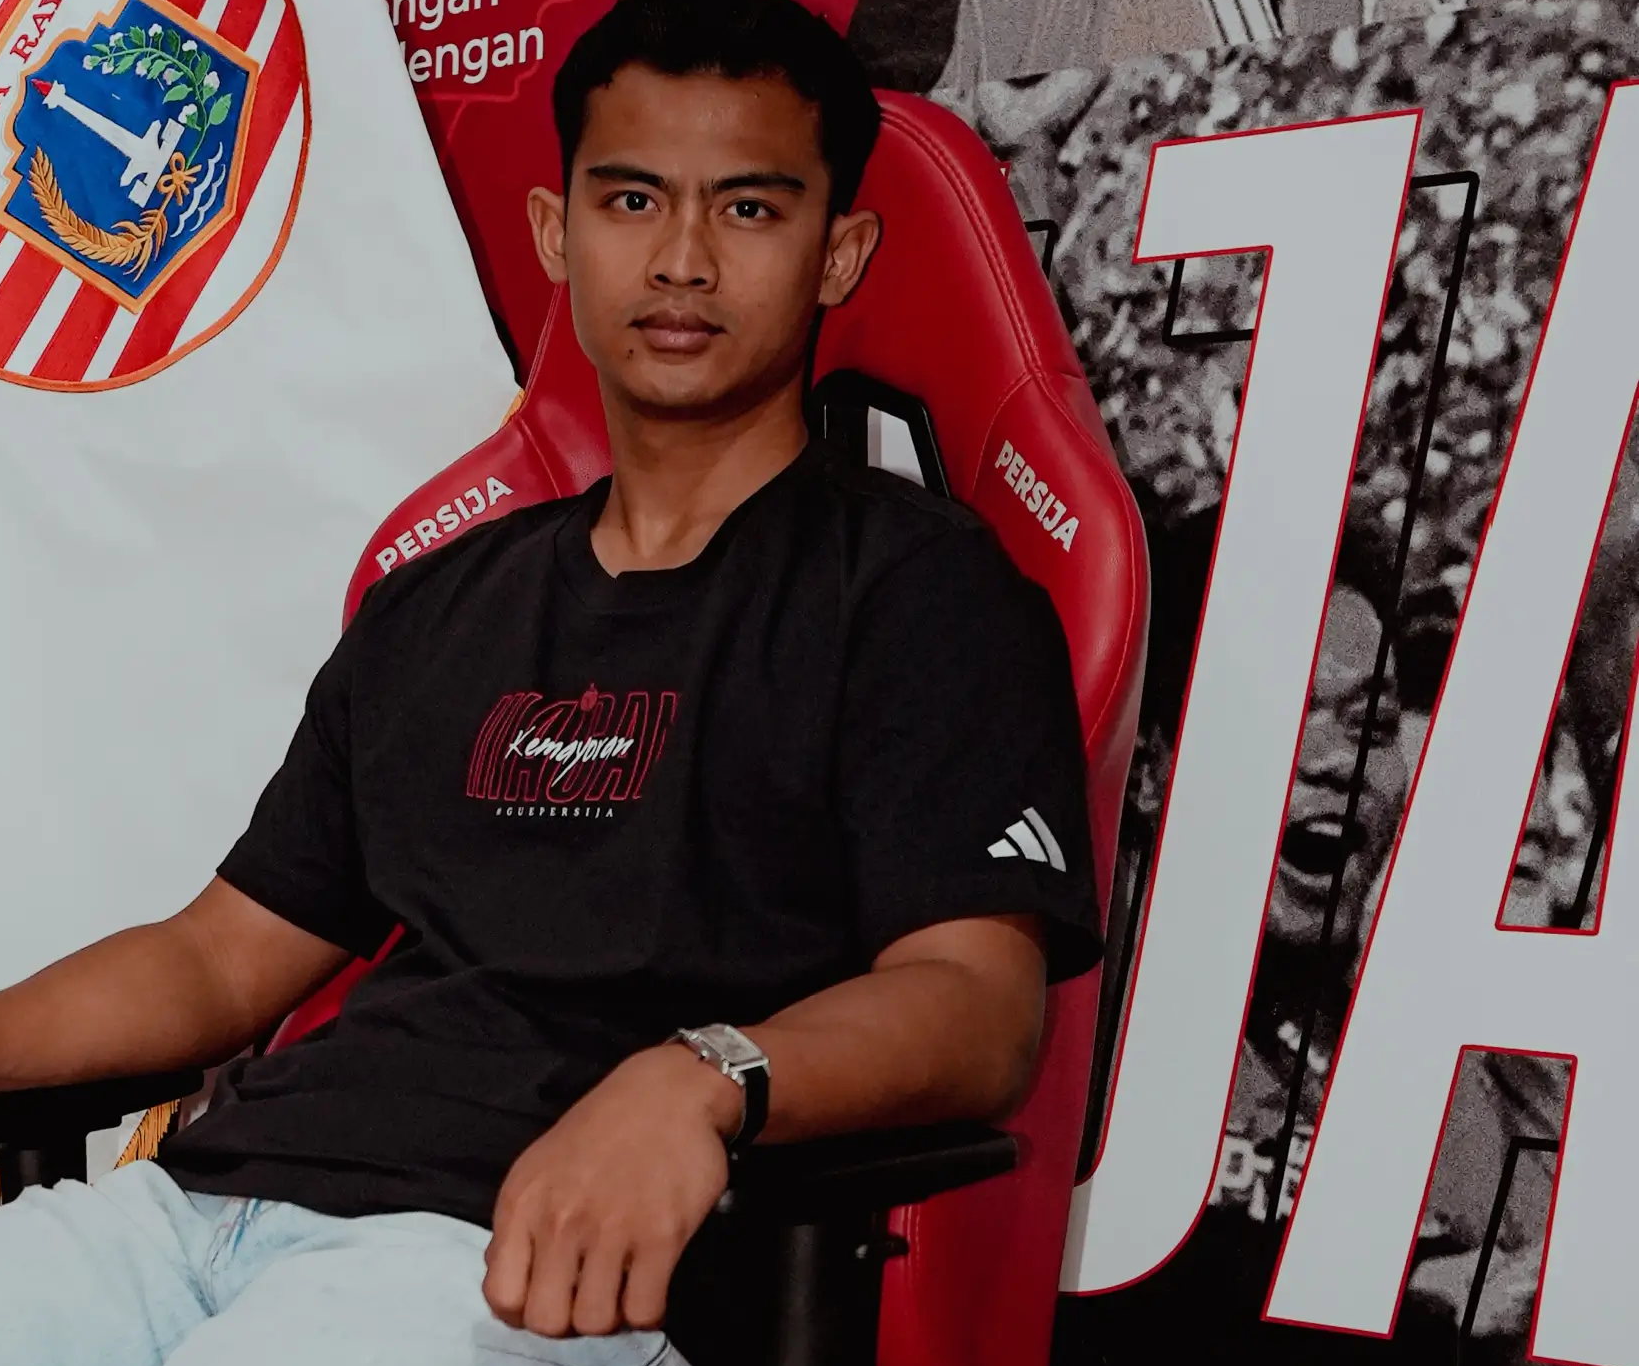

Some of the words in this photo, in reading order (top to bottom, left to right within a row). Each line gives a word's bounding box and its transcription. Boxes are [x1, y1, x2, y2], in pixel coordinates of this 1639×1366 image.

[375, 476, 514, 576] PERSIJA
[994, 439, 1080, 553] PERSIJA
[505, 725, 635, 788] Kemayoran
[495, 806, 614, 819] #GUEPERSIJA
